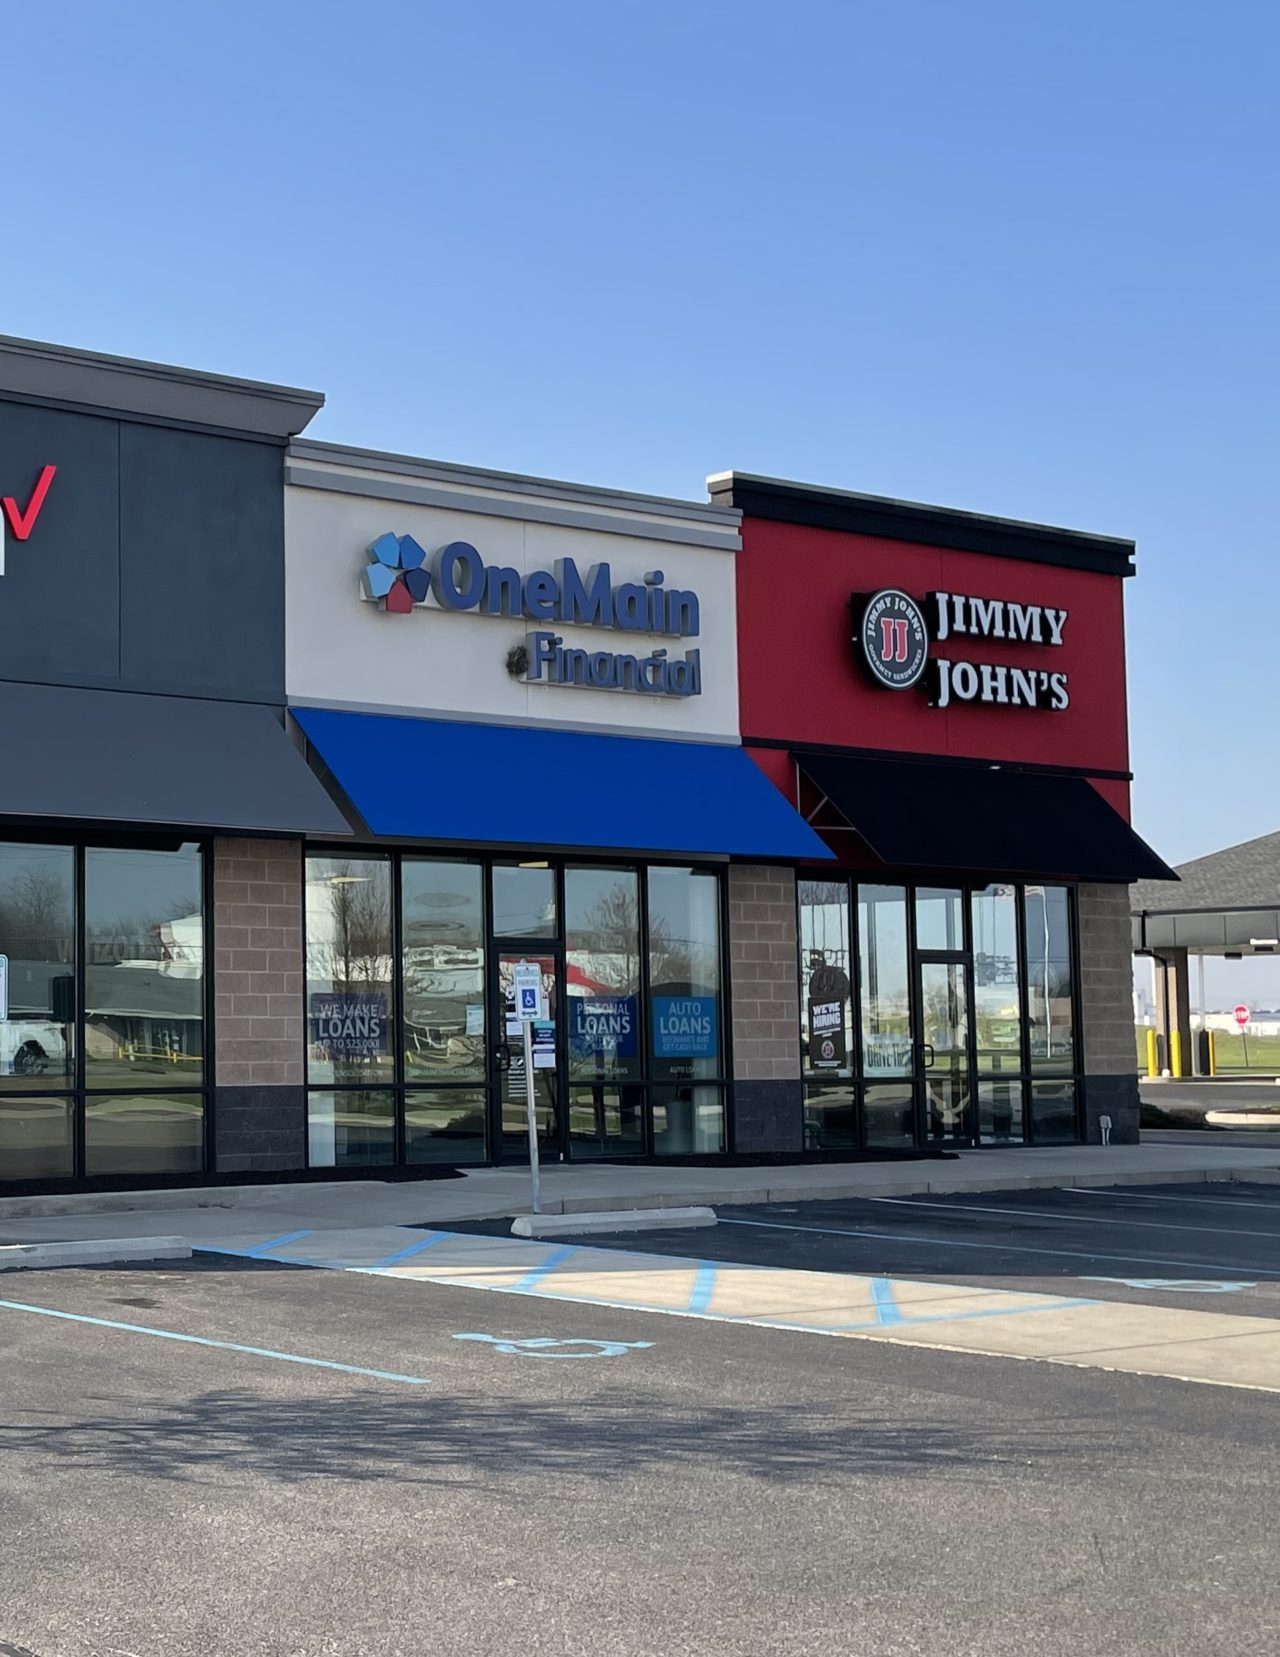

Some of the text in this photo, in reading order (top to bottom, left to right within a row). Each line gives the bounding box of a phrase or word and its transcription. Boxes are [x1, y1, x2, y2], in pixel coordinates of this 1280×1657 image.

[431, 541, 700, 636] OneMain
[867, 597, 923, 641] JIMMY JOHN'S
[935, 592, 1067, 645] JIMMY
[881, 618, 908, 662] JJ
[526, 631, 701, 695] Financial
[937, 659, 1069, 709] JOHN'S
[320, 1003, 379, 1018] WE MAKE
[669, 1002, 702, 1015] AUTO
[319, 1018, 381, 1038] LOANS
[577, 1016, 631, 1034] LOANS
[660, 1016, 712, 1035] LOANS
[331, 1039, 344, 1048] TO
